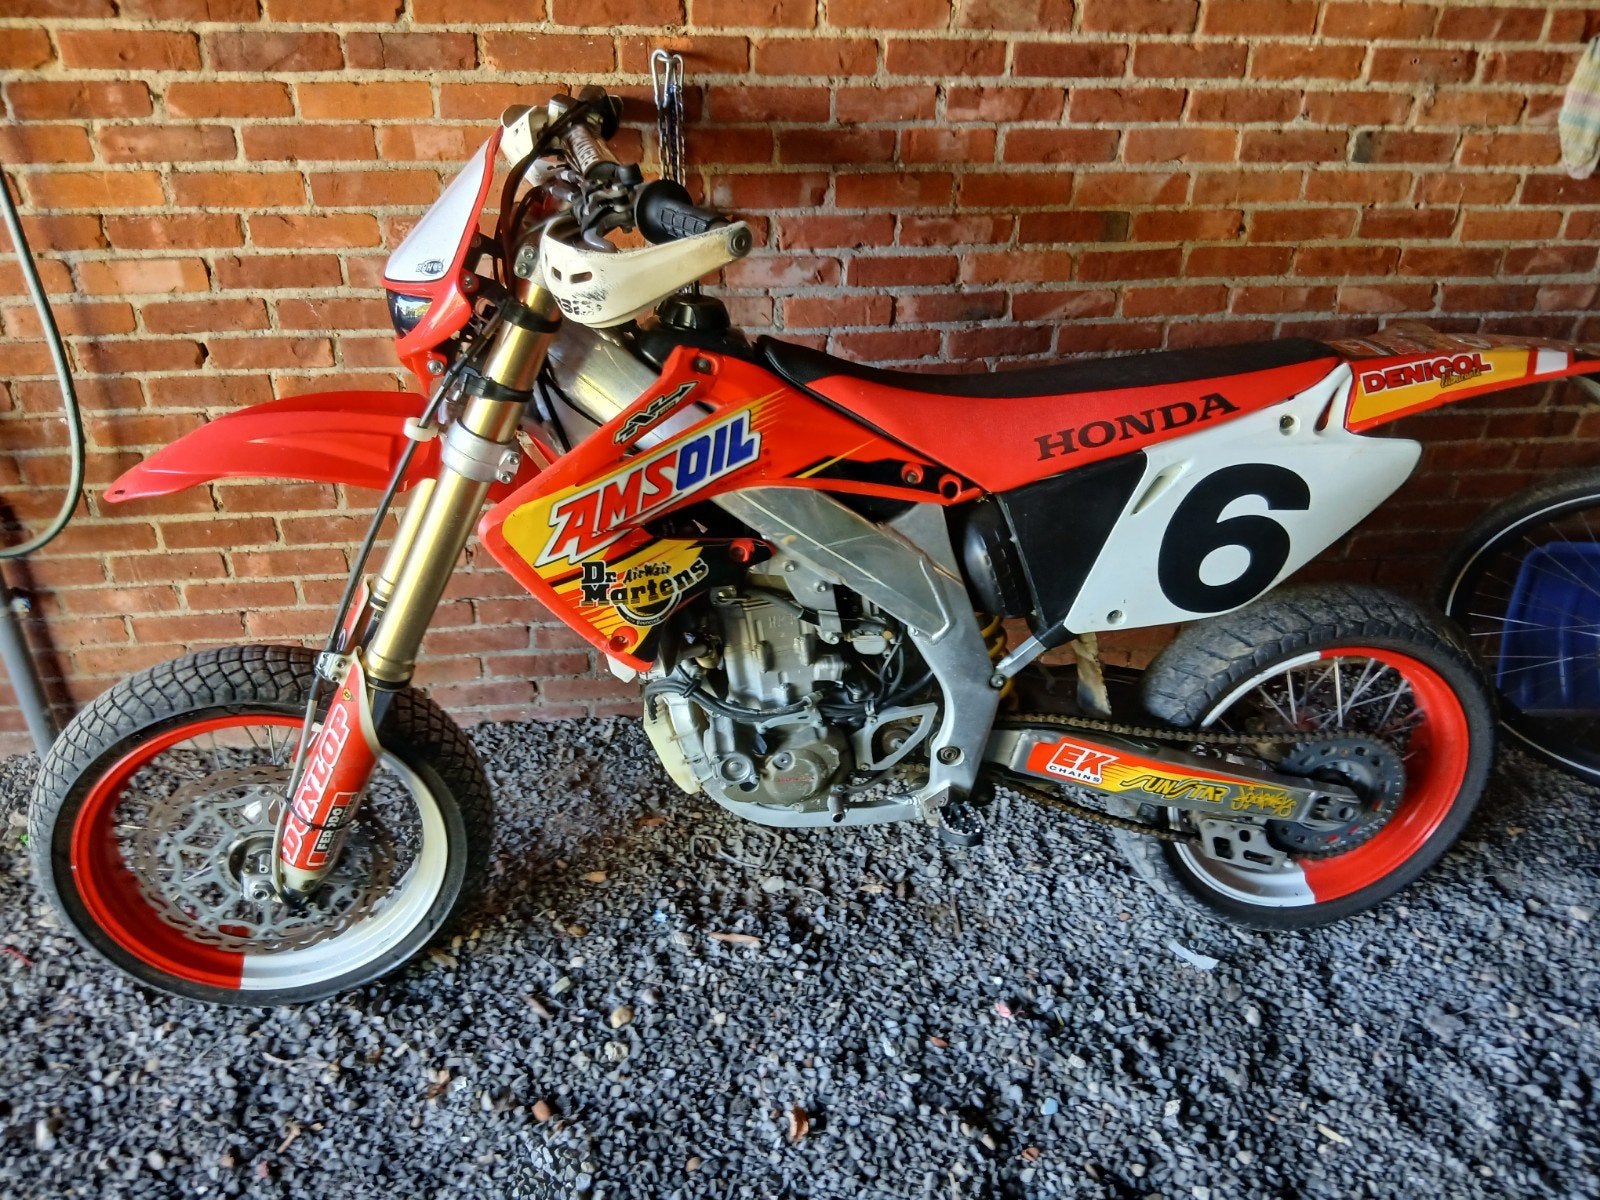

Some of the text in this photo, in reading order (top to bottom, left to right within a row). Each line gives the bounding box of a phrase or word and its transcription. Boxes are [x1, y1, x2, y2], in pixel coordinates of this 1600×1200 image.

[1361, 353, 1492, 395] DENICOL
[1035, 393, 1240, 461] HONDA
[536, 410, 760, 566] AMSOIL
[1158, 463, 1311, 613] 6
[580, 558, 709, 606] Martens
[282, 703, 351, 866] DUNLOP
[1048, 764, 1102, 784] CHAINS
[1051, 743, 1119, 776] EK
